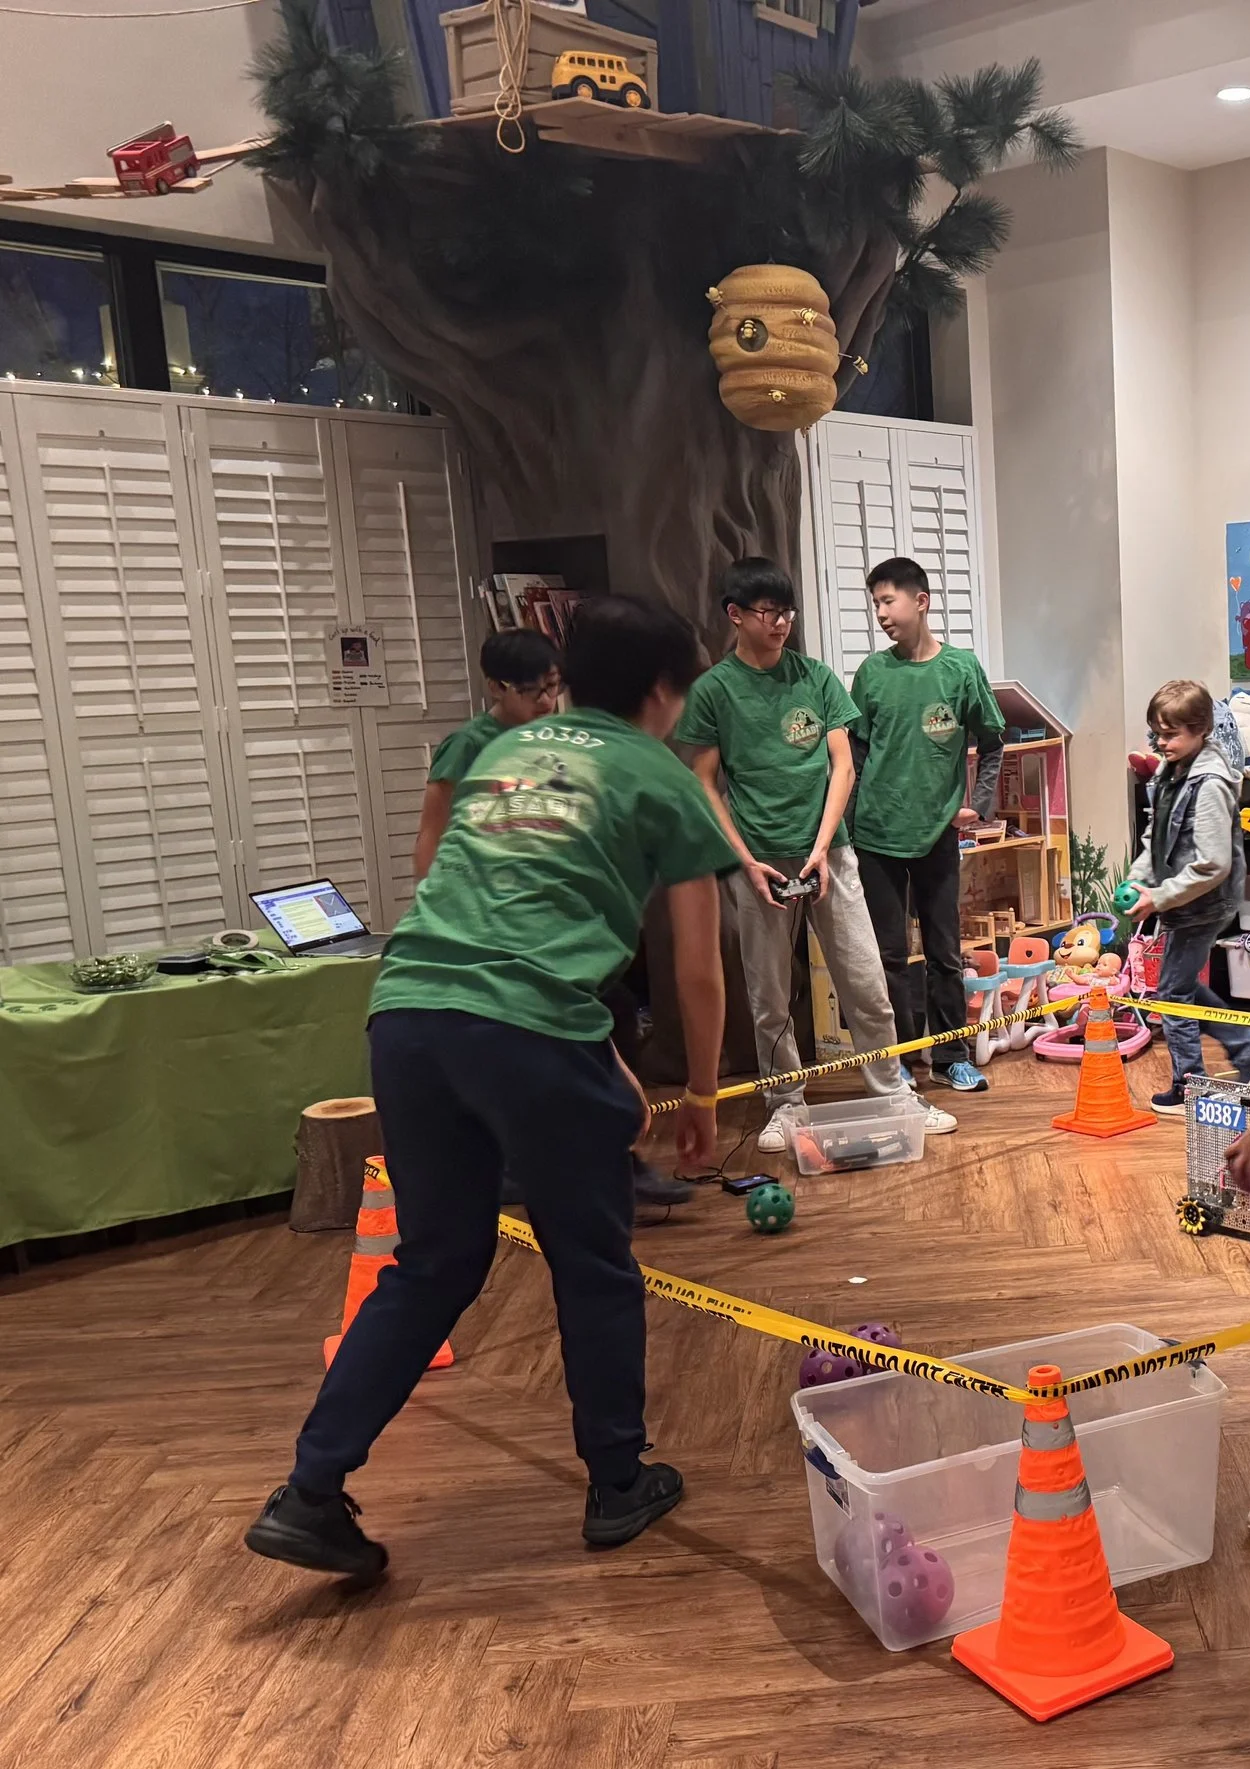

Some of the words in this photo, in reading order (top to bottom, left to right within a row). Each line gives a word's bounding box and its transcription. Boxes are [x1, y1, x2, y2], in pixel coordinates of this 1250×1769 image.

[518, 727, 605, 748] 30387
[467, 795, 580, 821] WASABI
[1198, 1101, 1243, 1128] 30387
[800, 1334, 873, 1369] CAUTION
[903, 1358, 944, 1382] NOT
[1104, 1364, 1130, 1385] DO
[1133, 1355, 1168, 1378] NOT
